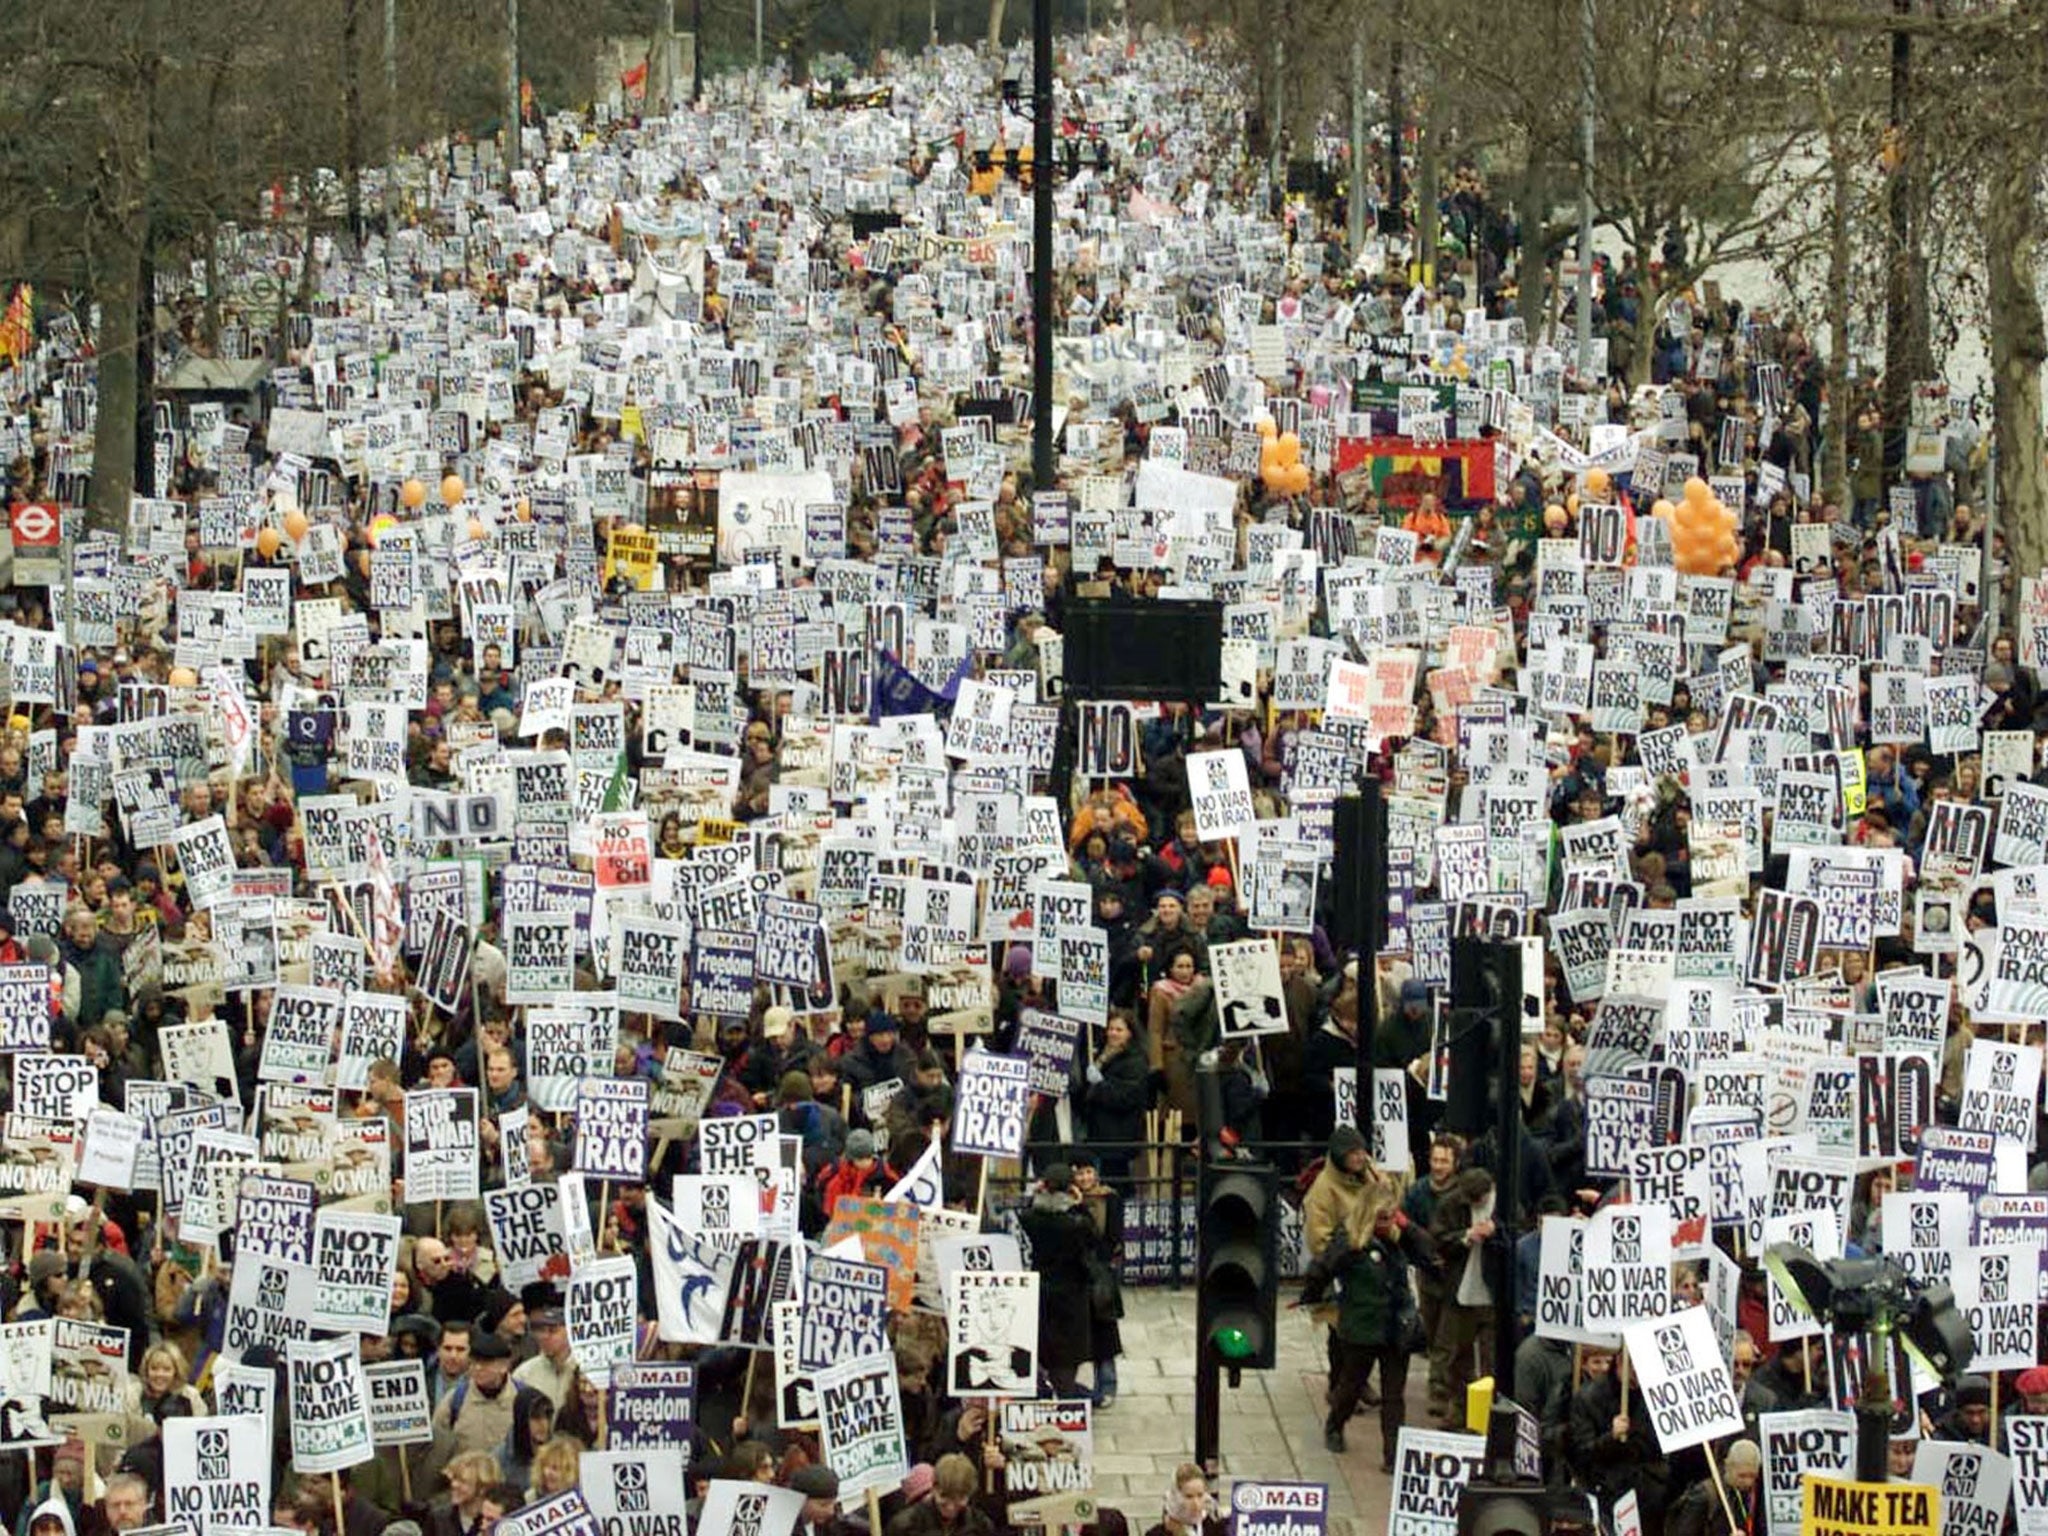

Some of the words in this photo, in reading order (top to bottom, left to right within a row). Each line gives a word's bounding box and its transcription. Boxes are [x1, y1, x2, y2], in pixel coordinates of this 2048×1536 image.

[1348, 330, 1371, 349] NO
[1379, 336, 1411, 353] WAR
[868, 448, 898, 491] NO
[762, 498, 797, 523] SAY
[502, 531, 537, 549] FREE
[614, 534, 639, 548] MAKE
[640, 535, 654, 548] TEA
[1581, 506, 1622, 563] NO
[901, 561, 939, 585] FREE
[248, 578, 285, 589] NOT
[1692, 587, 1729, 599] NOT
[1231, 611, 1268, 626] NOT
[1910, 593, 1954, 652] NO
[352, 655, 394, 668] NOT
[826, 651, 870, 713] NO
[988, 672, 1033, 687] STOP
[1929, 686, 1969, 700] DON'T
[954, 717, 972, 732] NO
[1874, 708, 1892, 723] NO
[1894, 708, 1921, 721] WAR
[1932, 713, 1969, 728] IRAQ
[1324, 722, 1368, 752] FREE
[1640, 727, 1685, 746] STOP
[1874, 722, 1892, 735] ON
[1895, 721, 1921, 736] IRAQ
[352, 739, 369, 754] NO
[372, 740, 399, 756] WAR
[950, 734, 968, 750] ON
[1081, 705, 1132, 773] NO
[1646, 744, 1676, 761] THE
[350, 755, 369, 771] ON
[371, 755, 399, 773] IRAQ
[517, 764, 567, 779] NOT
[1649, 757, 1688, 776] WAR
[541, 778, 568, 792] MY
[1782, 784, 1830, 801] NOT
[1197, 794, 1217, 810] NO
[1218, 791, 1248, 810] WAR
[1801, 801, 1827, 815] MY
[1199, 811, 1220, 829] ON
[1222, 807, 1251, 825] IRAQ
[178, 828, 221, 853] NOT
[605, 826, 629, 838] NO
[609, 857, 631, 868] for
[824, 850, 875, 867] NOT
[1439, 844, 1487, 861] DON'T
[993, 857, 1047, 874] STOP
[991, 875, 1028, 892] THE
[12, 894, 61, 908] DON'T
[700, 891, 749, 927] FREE
[991, 893, 1035, 911] WAR
[763, 917, 819, 937] DON'T
[1681, 911, 1735, 928] NOT
[514, 924, 569, 943] NOT
[625, 931, 678, 951] NOT
[907, 926, 927, 943] NO
[1559, 921, 1608, 942] NOT
[542, 943, 568, 955] MY
[931, 946, 987, 965] Mirror
[1061, 938, 1104, 957] NOT
[1215, 944, 1269, 956] PEACE
[1678, 941, 1735, 954] NAME
[698, 952, 754, 975] Freedom
[1616, 953, 1668, 964] PEACE
[693, 983, 752, 1014] Palestine
[928, 986, 949, 1008] NO
[951, 986, 988, 1007] WAR
[1890, 991, 1945, 1010] NOT
[277, 999, 333, 1017] NOT
[350, 1005, 400, 1022] DON'T
[1602, 1005, 1659, 1022] DON'T
[271, 1029, 328, 1047] NAME
[531, 1022, 586, 1041] DON'T
[1591, 1031, 1651, 1052] IRAQ
[531, 1040, 585, 1054] ATTACK
[1017, 1026, 1075, 1059] Freedom
[531, 1054, 587, 1077] IRAQ
[985, 1061, 1024, 1075] MAB
[31, 1071, 94, 1093] STOP
[603, 1081, 644, 1096] MAB
[962, 1075, 1025, 1096] DON'T
[1705, 1073, 1764, 1093] DON'T
[272, 1085, 333, 1112] Mirror
[960, 1098, 1024, 1117] ATTACK
[1966, 1089, 1990, 1110] NO
[1993, 1099, 2032, 1121] WAR
[181, 1112, 219, 1129] MAB
[577, 1099, 646, 1122] DON'T
[1587, 1099, 1654, 1122] DON'T
[581, 1122, 644, 1140] ATTACK
[704, 1120, 776, 1145] STOP
[954, 1112, 1024, 1152] IRAQ
[1588, 1120, 1653, 1140] ATTACK
[1947, 1135, 1989, 1150] MAB
[576, 1137, 644, 1172] IRAQ
[704, 1145, 755, 1166] THE
[1637, 1150, 1706, 1175] STOP
[1635, 1174, 1685, 1197] THE
[1775, 1169, 1847, 1195] NOT
[264, 1184, 309, 1201] MAB
[489, 1185, 559, 1219] STOP
[241, 1201, 311, 1224] DON'T
[240, 1223, 308, 1243] ATTACK
[495, 1213, 546, 1239] THE
[321, 1228, 393, 1252] NOT
[500, 1233, 566, 1263] WAR
[352, 1254, 390, 1271] MY
[318, 1267, 388, 1287] NAME
[835, 1267, 883, 1287] MAB
[960, 1276, 1030, 1288] PEACE
[1587, 1267, 1616, 1292] NO
[1622, 1266, 1667, 1292] WAR
[571, 1276, 632, 1306] NOT
[806, 1282, 886, 1307] DON'T
[1587, 1295, 1615, 1317] ON
[1989, 1303, 2033, 1328] WAR
[806, 1306, 882, 1334] ATTACK
[56, 1323, 125, 1350] Mirror
[569, 1321, 632, 1341] NAME
[1988, 1329, 2033, 1356] IRAQ
[293, 1353, 353, 1385] NOT
[641, 1369, 690, 1385] MAB
[52, 1377, 75, 1402] NO
[372, 1376, 419, 1399] END
[823, 1372, 890, 1410] NOT
[1648, 1381, 1679, 1408] NO
[1680, 1368, 1728, 1400] WAR
[295, 1397, 361, 1421] NAME
[372, 1401, 425, 1414] ISRAELI
[614, 1391, 690, 1421] Freedom
[1656, 1409, 1688, 1435] ON
[1689, 1393, 1735, 1427] IRAQ
[1007, 1402, 1086, 1432] Mirror
[639, 1423, 662, 1435] For
[829, 1413, 896, 1445] NAME
[1770, 1429, 1848, 1454] NOT
[1007, 1460, 1036, 1491] NO
[1043, 1459, 1092, 1490] WAR
[171, 1488, 201, 1512] NO
[209, 1482, 260, 1508] WAR
[1266, 1490, 1320, 1507] MAB
[1814, 1484, 1878, 1526] MAKE
[1885, 1492, 1929, 1526] TEA
